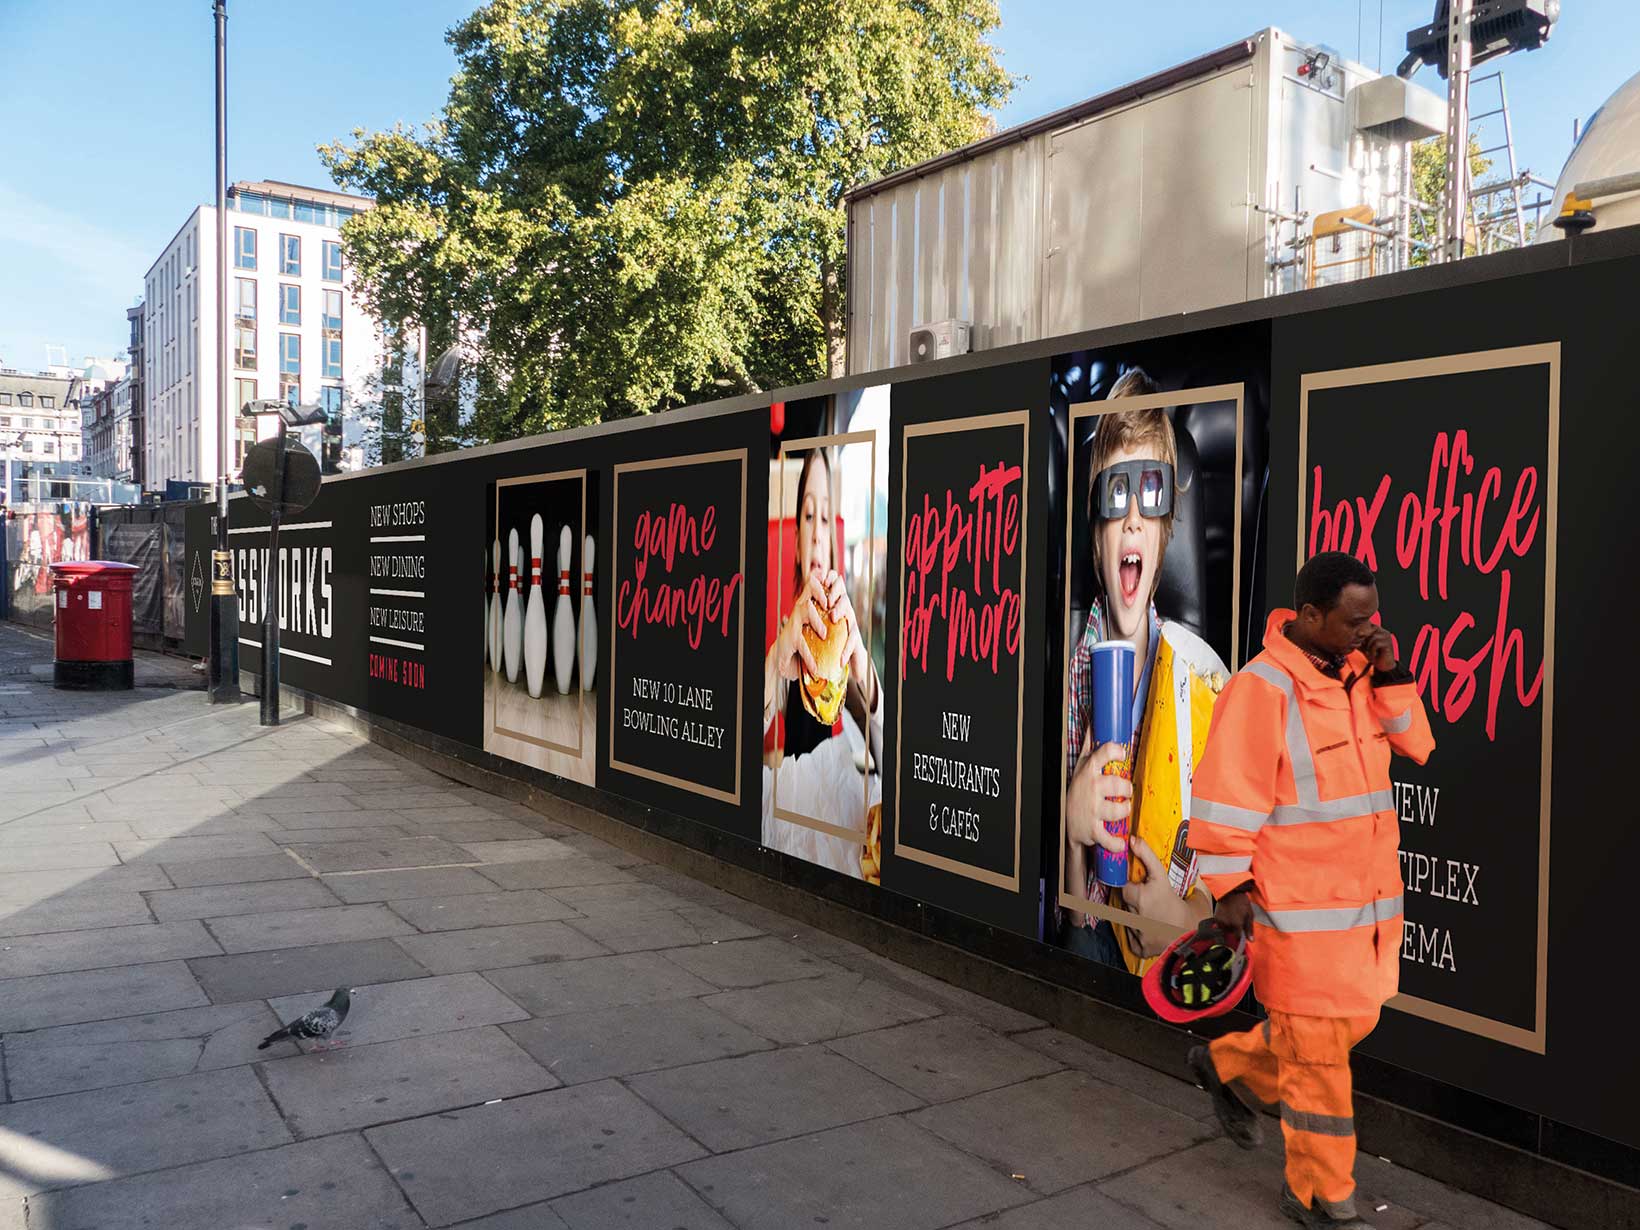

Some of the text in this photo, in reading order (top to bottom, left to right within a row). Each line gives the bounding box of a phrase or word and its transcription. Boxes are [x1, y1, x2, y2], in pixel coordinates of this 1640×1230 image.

[370, 501, 425, 527] NEW SHOPS
[1309, 429, 1540, 600] box office
[634, 503, 717, 582] game
[370, 556, 425, 578] NEW DINING
[211, 547, 333, 638] SSORKS
[618, 561, 744, 650] changer
[370, 607, 425, 632] NEW LEISURE
[903, 570, 1021, 682] for more
[369, 653, 425, 689] COMING SOON
[1369, 569, 1544, 741] ash
[632, 677, 713, 711] NEW 10 LANE
[623, 708, 725, 749] BOWLING ALLEY
[942, 711, 971, 742] NEW
[913, 752, 1000, 798] RESTAURANTS
[929, 803, 980, 842] & CAFÉS
[1397, 850, 1480, 906] IPLEX
[1402, 920, 1457, 973] EMA
